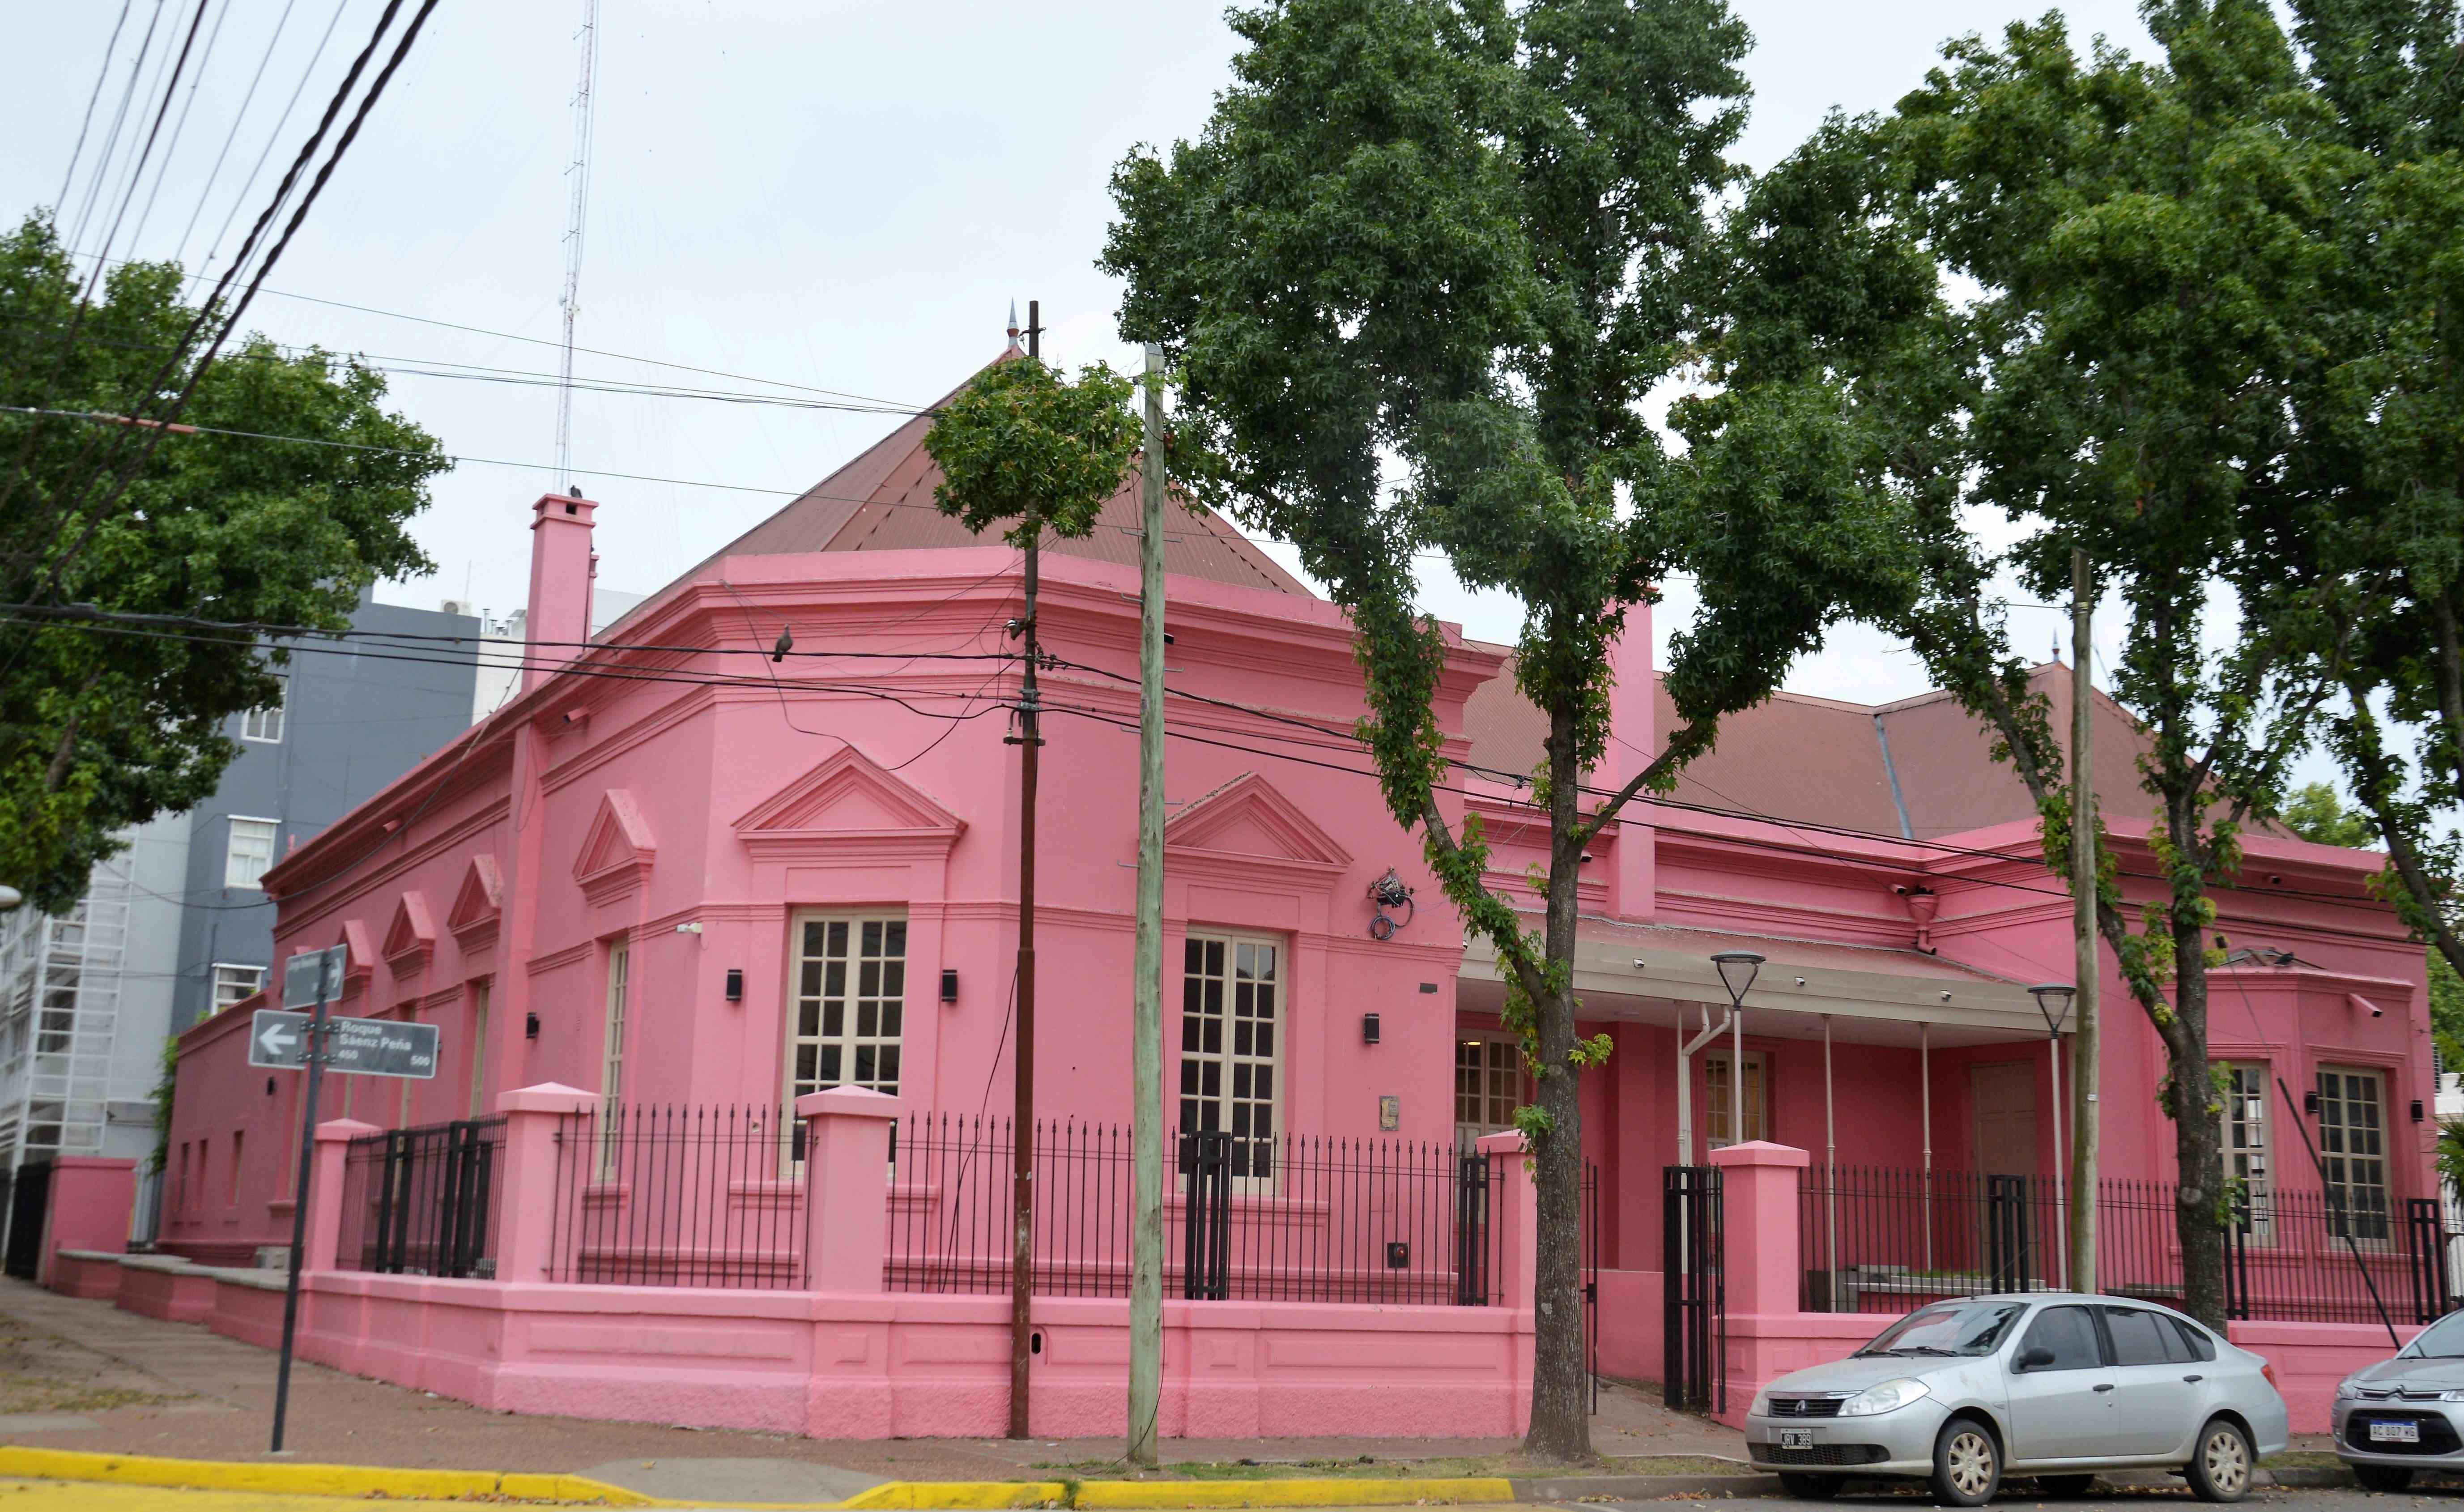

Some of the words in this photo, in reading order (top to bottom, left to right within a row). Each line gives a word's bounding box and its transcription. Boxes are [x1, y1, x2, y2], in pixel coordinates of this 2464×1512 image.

[340, 1020, 383, 1035] Roque
[339, 1034, 379, 1048] Sáenz
[380, 1037, 412, 1052] Peña
[410, 1055, 430, 1067] 500
[1782, 1434, 1794, 1445] JRV
[1798, 1434, 1810, 1445] 389
